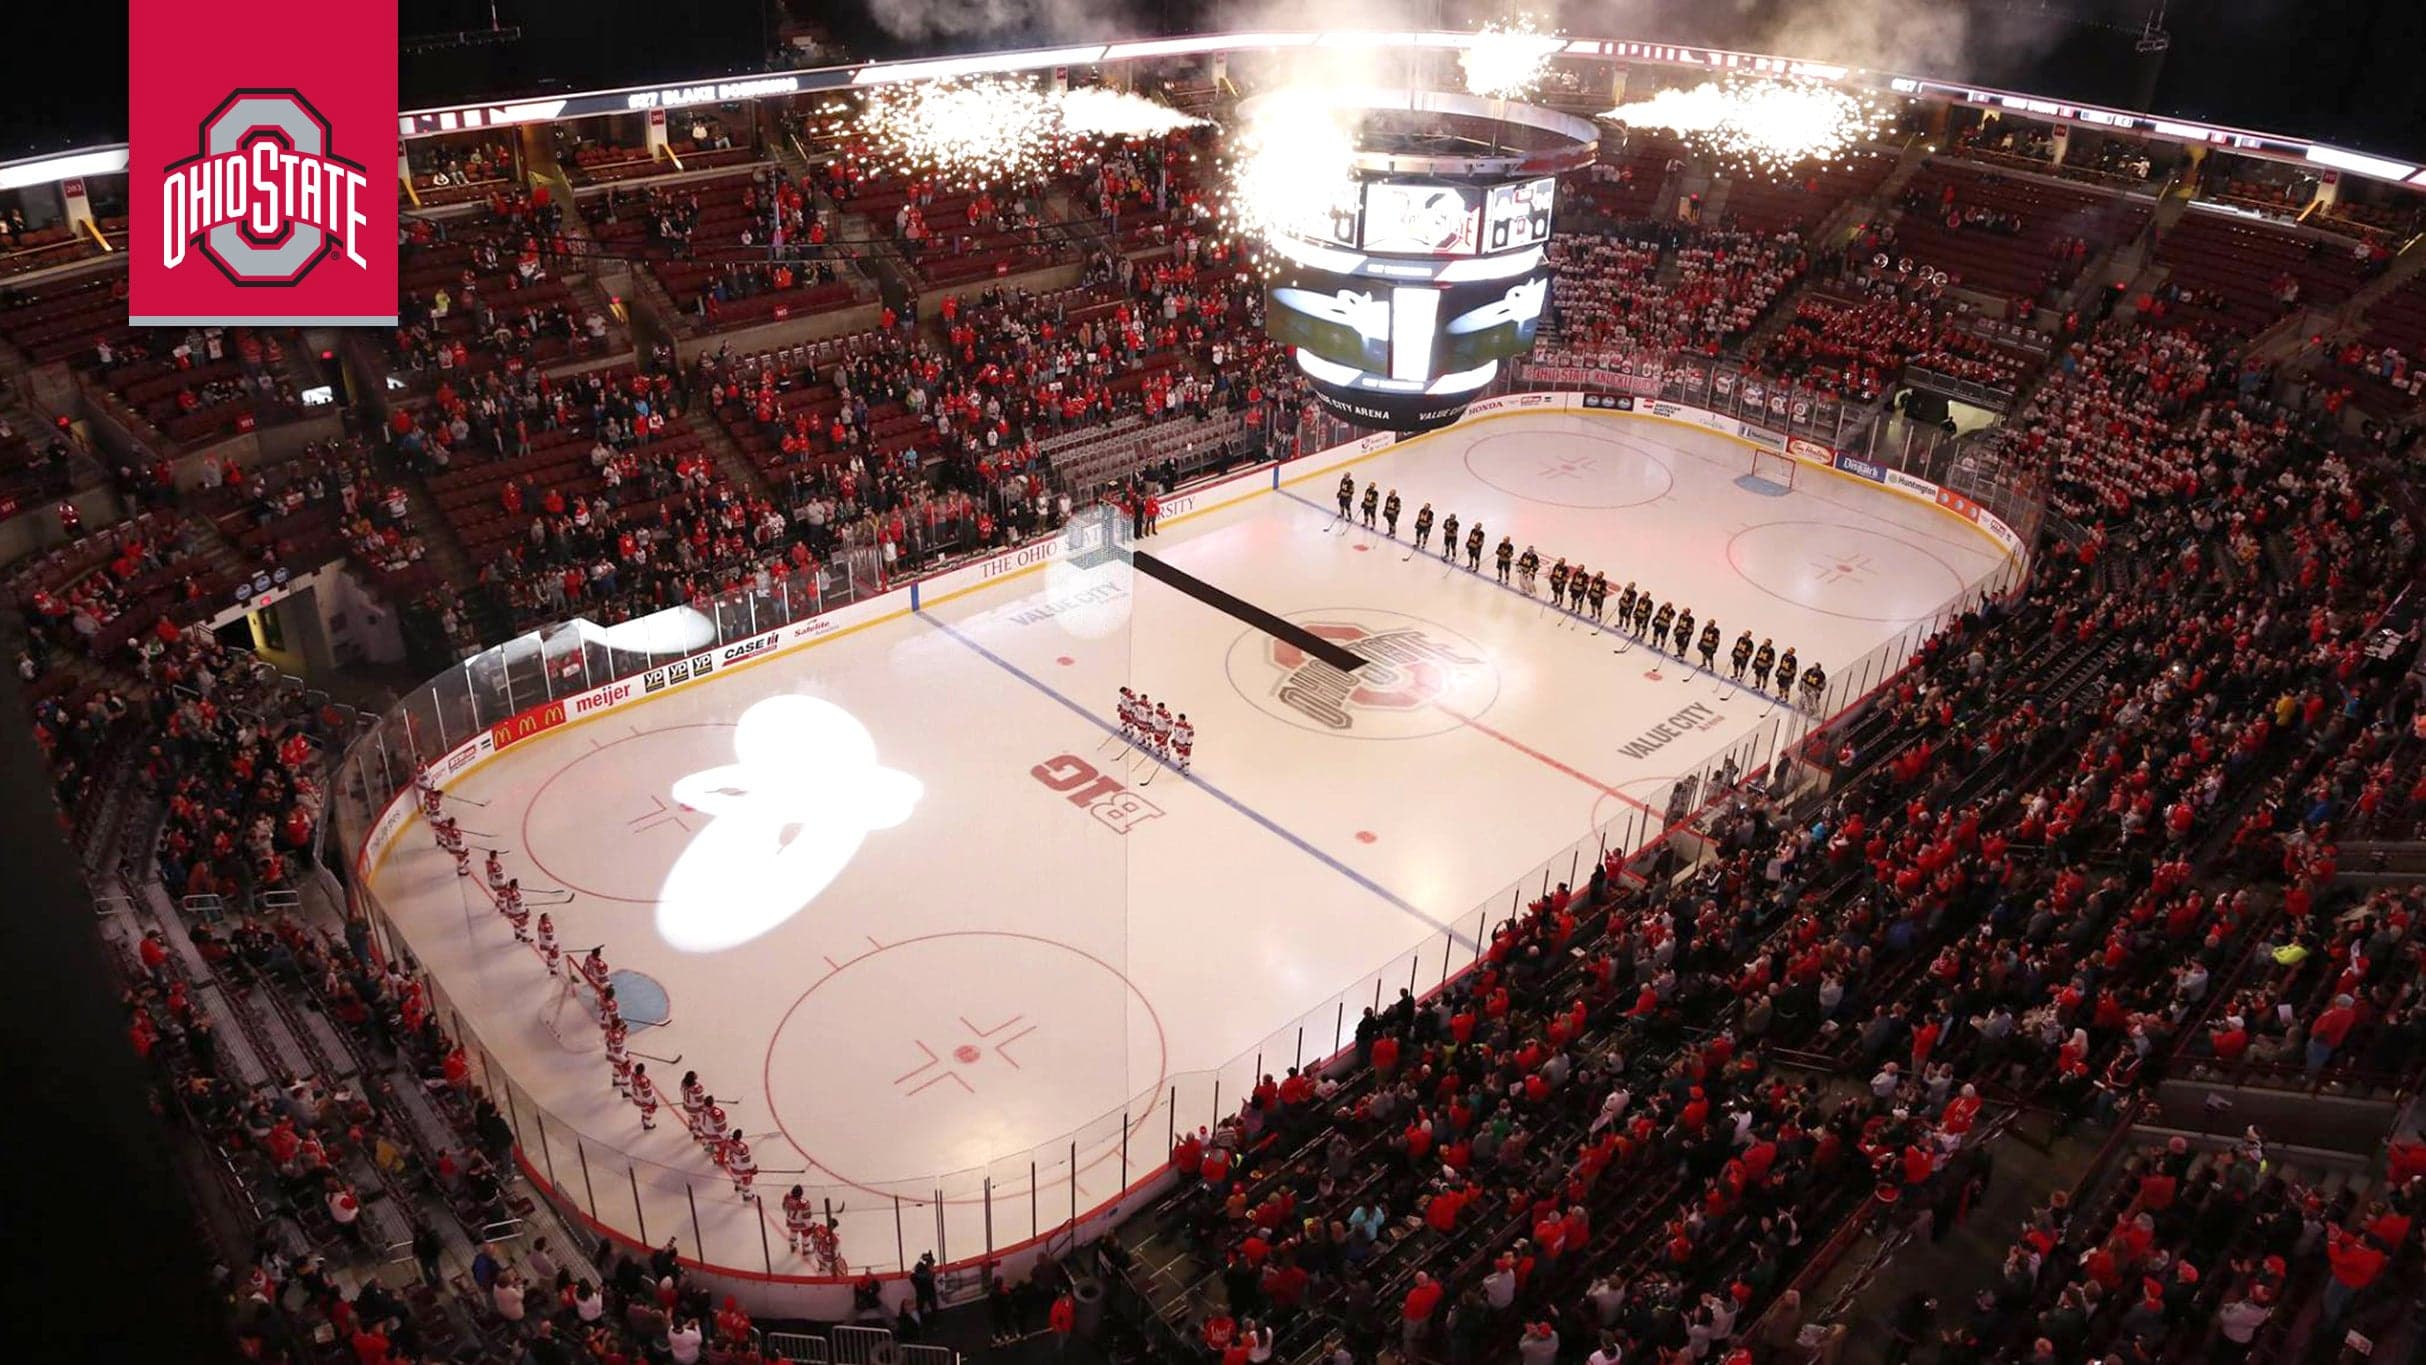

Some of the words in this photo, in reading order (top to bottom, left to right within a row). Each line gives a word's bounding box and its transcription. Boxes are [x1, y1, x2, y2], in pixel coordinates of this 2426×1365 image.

[1332, 400, 1353, 413] CITY
[1355, 405, 1390, 420] ARENA
[1419, 408, 1450, 421] VALUE
[1468, 402, 1504, 417] HONDA
[1898, 476, 1936, 496] Huntington
[981, 558, 1012, 579] THE
[1017, 541, 1057, 567] OHIO
[724, 639, 765, 659] CASE
[576, 683, 631, 713] meijer
[1617, 723, 1683, 760] VALUE
[1668, 701, 1715, 731] CITY
